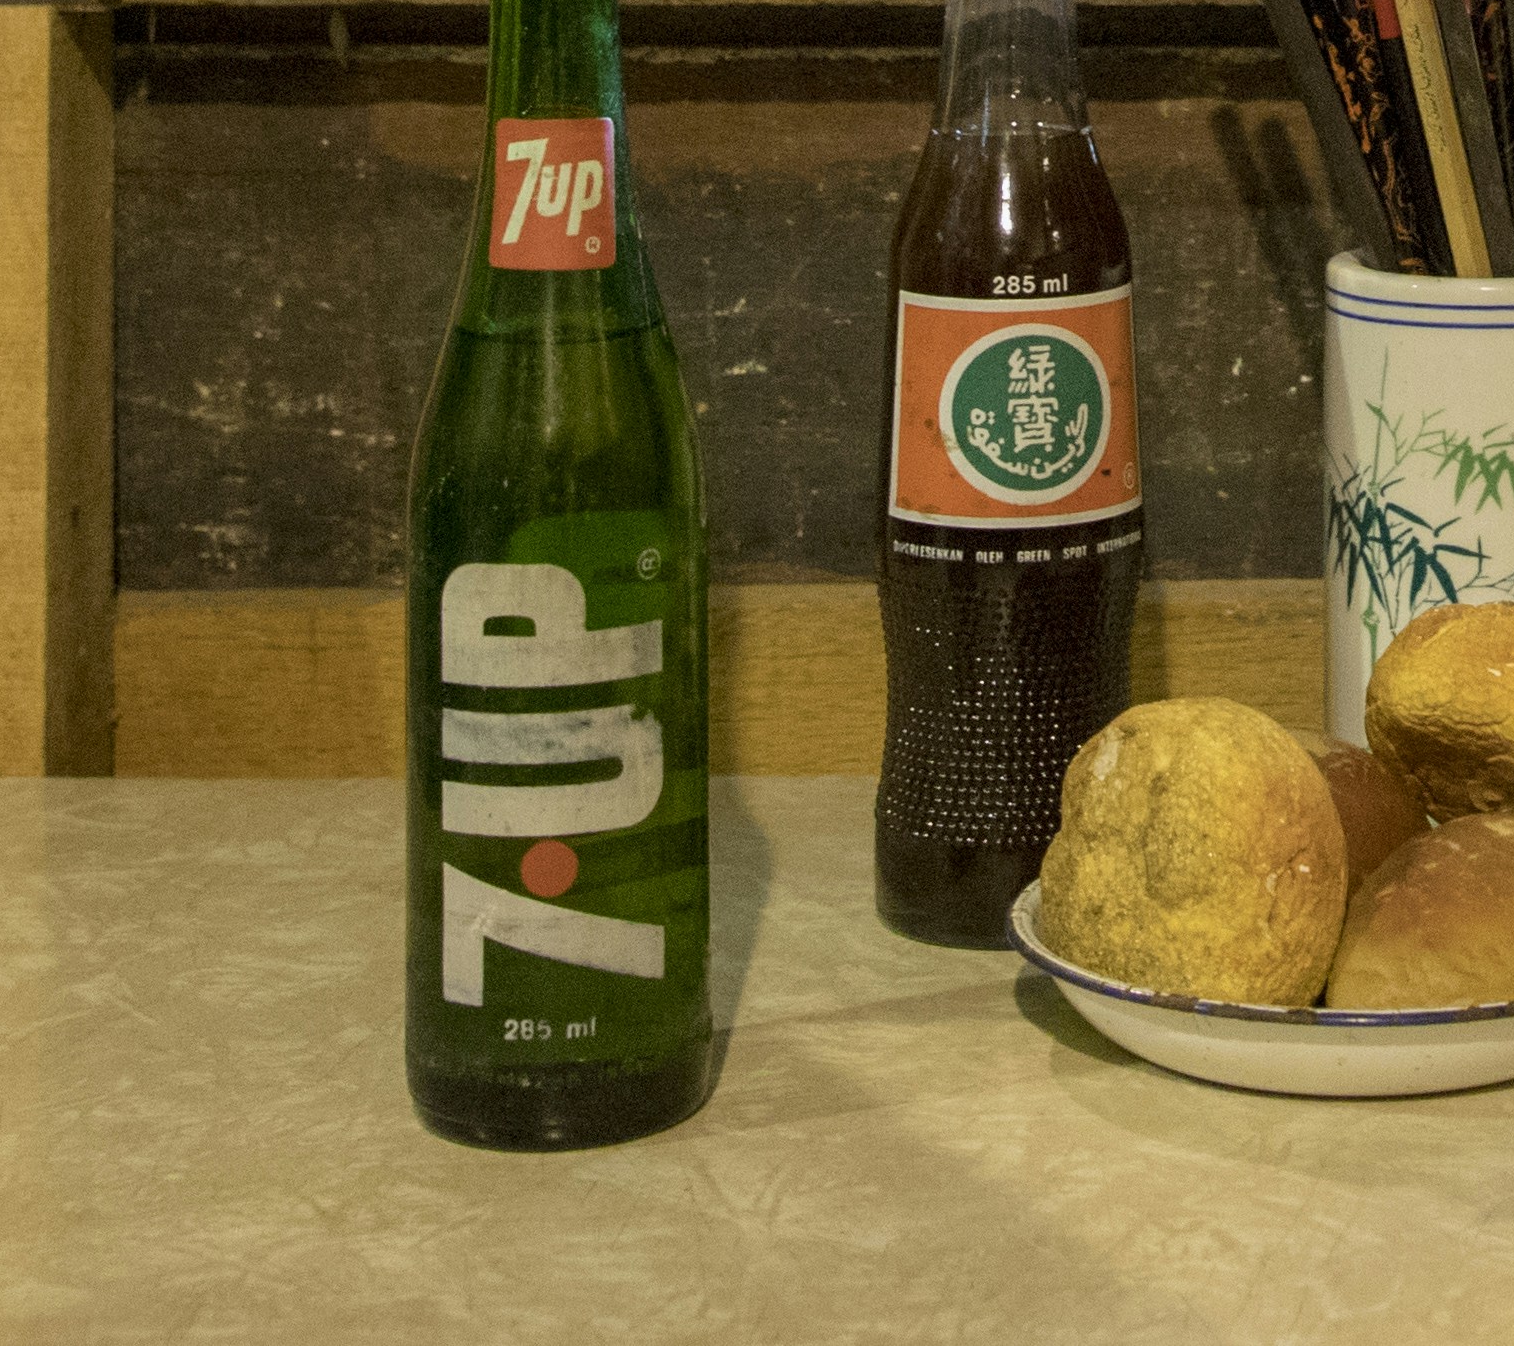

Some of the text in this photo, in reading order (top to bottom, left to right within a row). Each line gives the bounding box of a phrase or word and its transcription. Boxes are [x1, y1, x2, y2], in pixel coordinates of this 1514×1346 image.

[992, 273, 1069, 295] 285 ml
[1016, 549, 1052, 563] GREEN
[1062, 545, 1088, 559] SPOT
[504, 1016, 598, 1041] 285 ml
